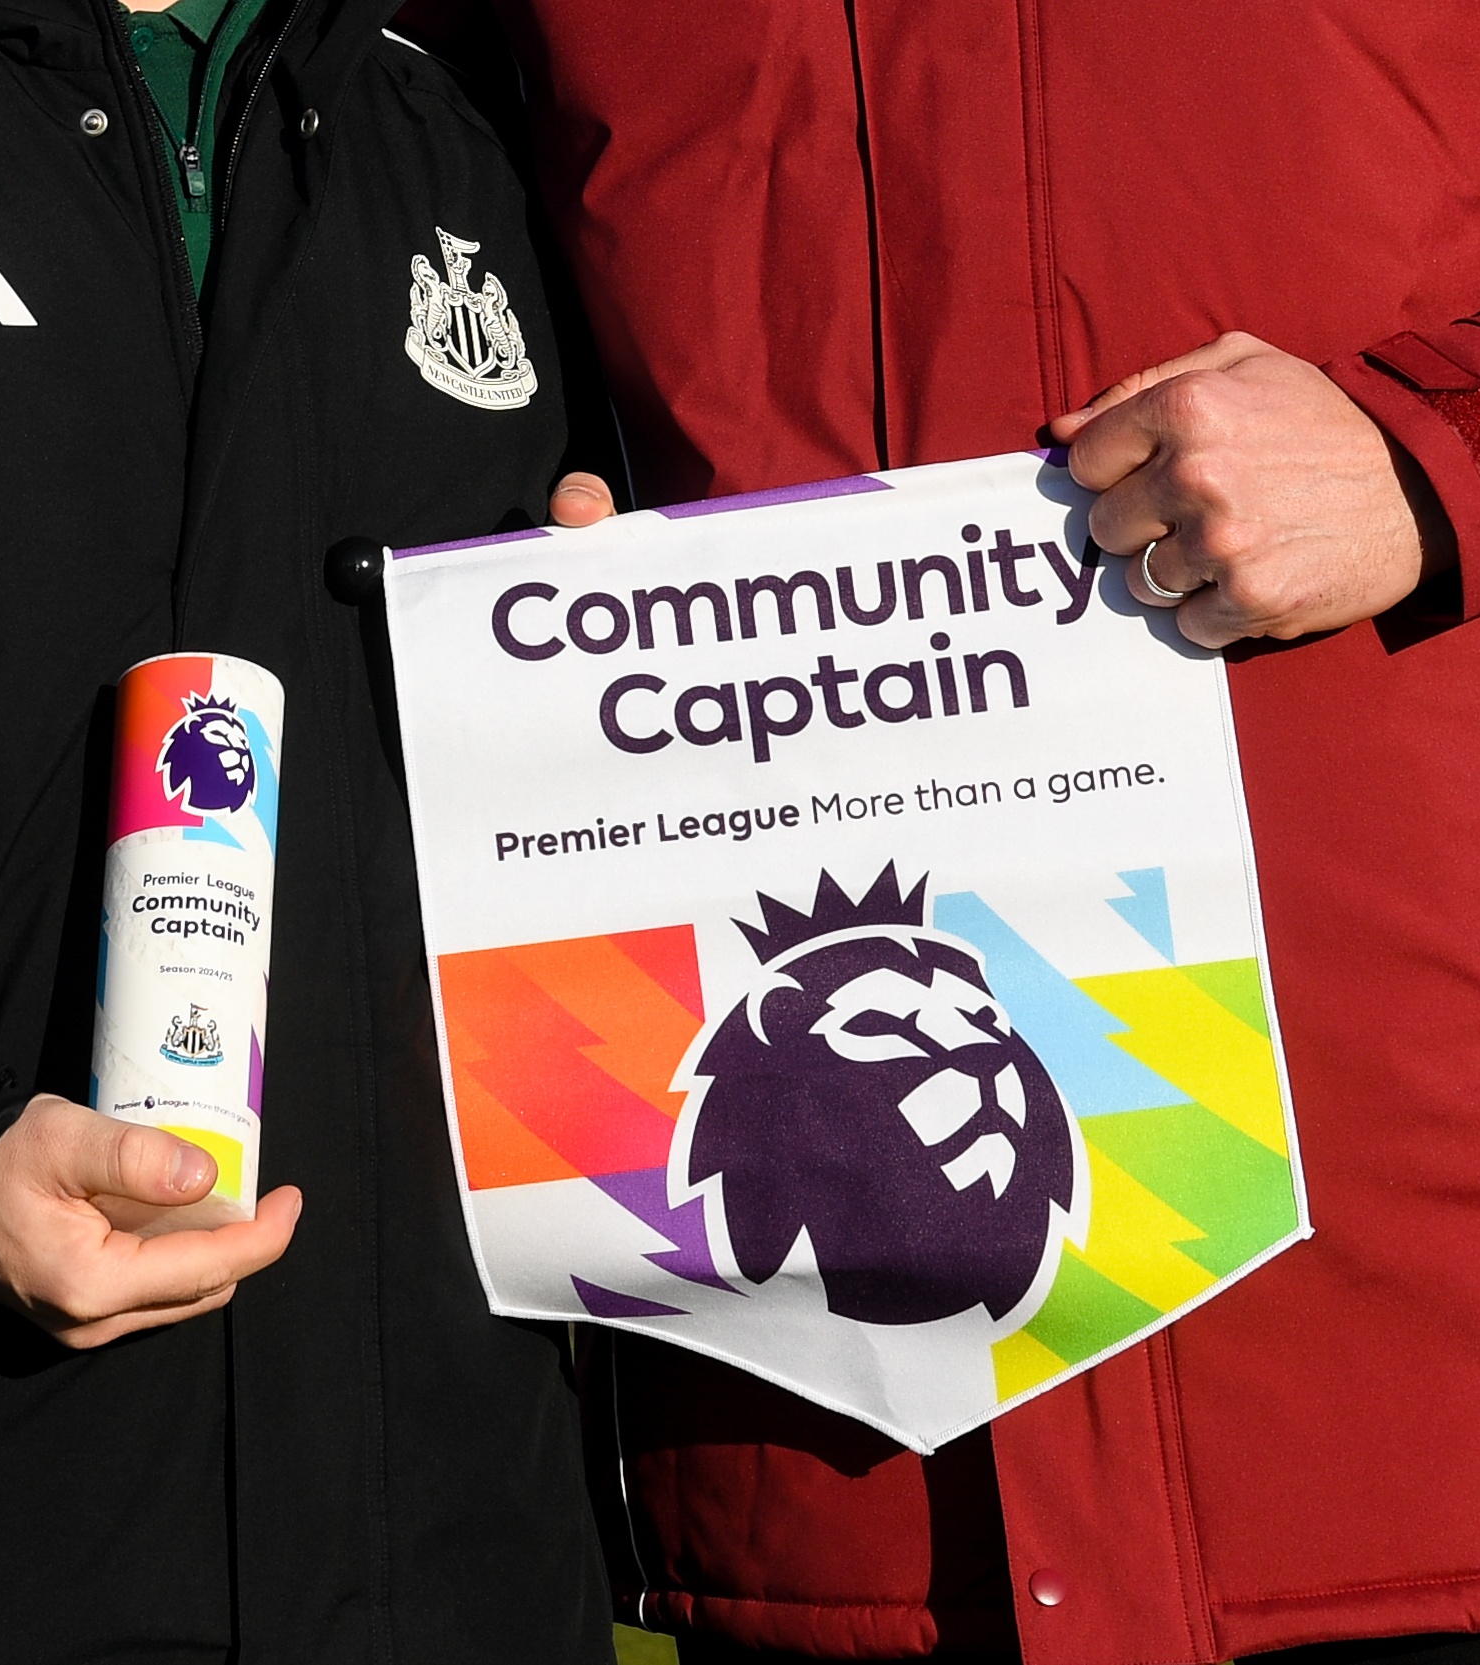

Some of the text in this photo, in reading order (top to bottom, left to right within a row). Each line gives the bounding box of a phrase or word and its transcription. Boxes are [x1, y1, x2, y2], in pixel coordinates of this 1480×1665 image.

[427, 364, 522, 401] NEWCASTLE UNITED
[491, 523, 1098, 661] Community
[599, 632, 1029, 763] Captain
[495, 763, 1166, 862] Premier League More than a game.
[143, 872, 255, 900] Premier League
[132, 895, 260, 932] Community
[151, 917, 245, 946] Captain
[159, 965, 233, 982] Season 2024/25
[157, 1098, 190, 1108] League
